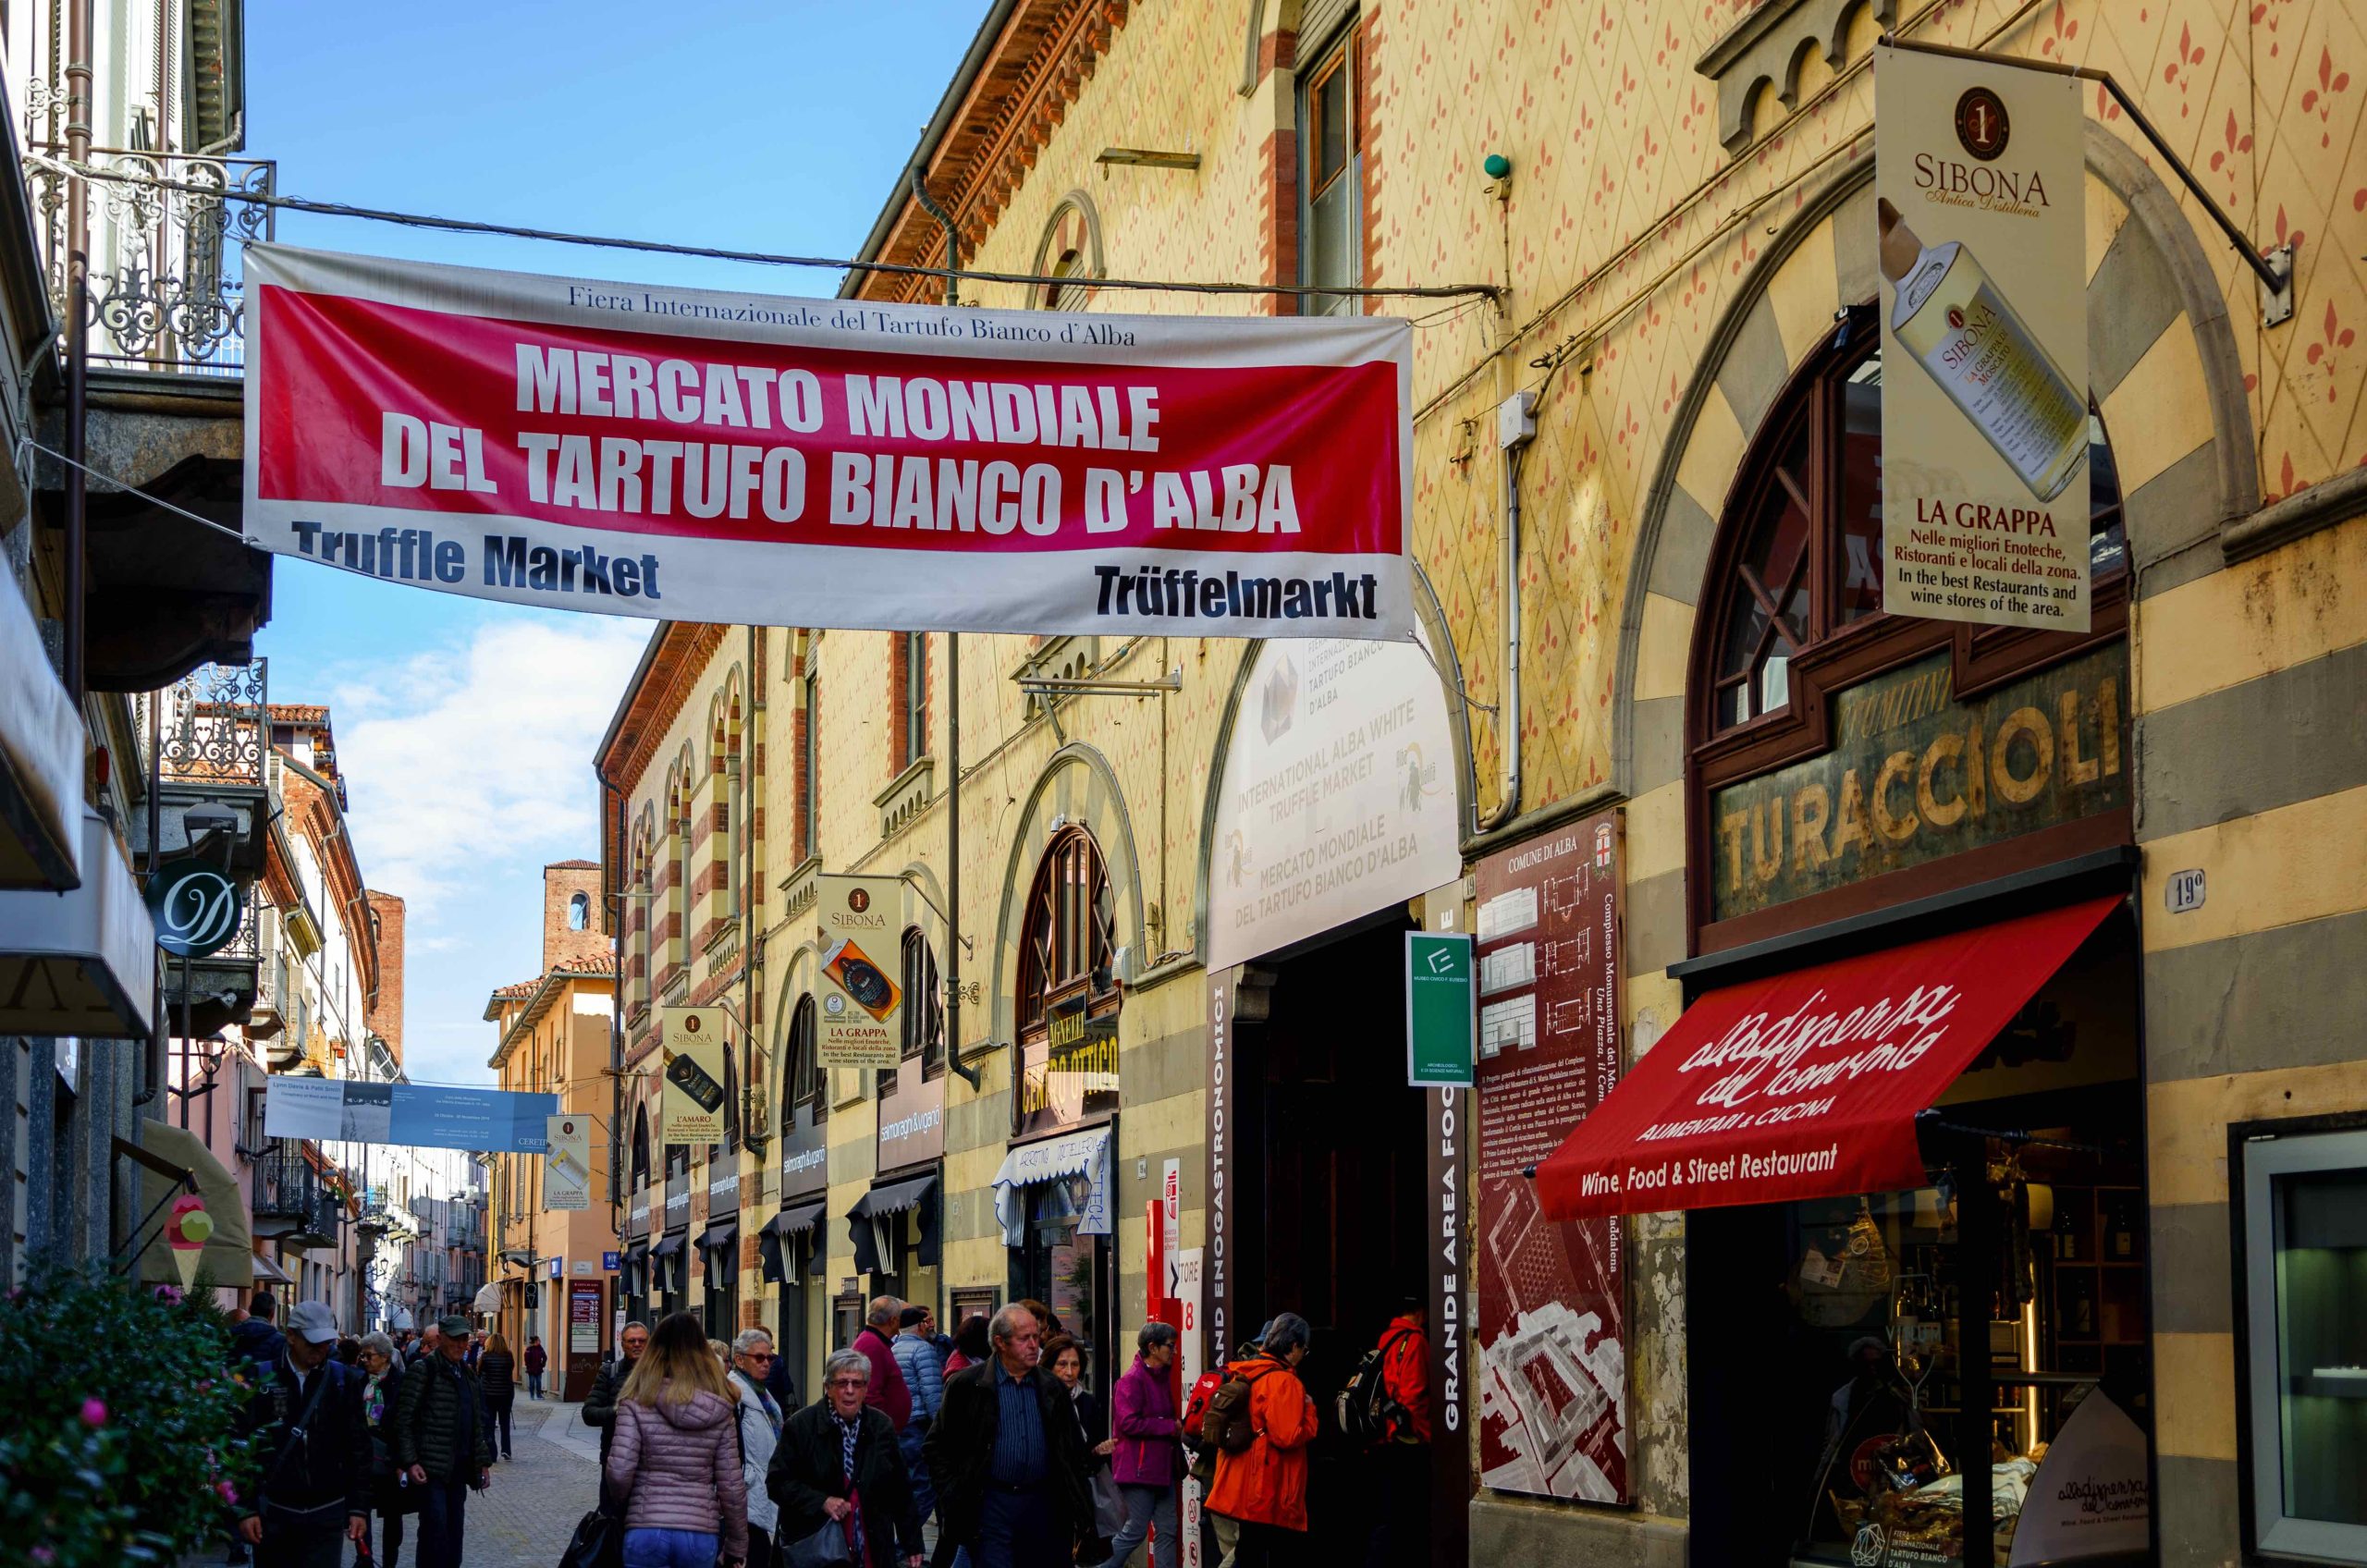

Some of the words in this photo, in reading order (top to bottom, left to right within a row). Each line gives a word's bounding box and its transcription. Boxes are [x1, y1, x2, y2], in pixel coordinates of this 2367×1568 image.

[1915, 153, 2051, 207] SIBONA
[1925, 189, 1975, 208] Antica
[1977, 192, 2040, 219] Distilleria
[568, 286, 633, 312] Fiera
[644, 293, 821, 328] Internazionale
[831, 312, 865, 332] del
[872, 312, 963, 338] Tartufo
[971, 318, 1051, 344] Bianco
[1060, 323, 1136, 347] d'Alba
[1942, 304, 1996, 370] SIBONA
[1977, 345, 2011, 386] MOSCATO
[515, 343, 825, 434] MERCATO
[845, 373, 1159, 453] MONDIALE
[381, 411, 498, 496] DEL
[517, 432, 807, 524] TARTUFO
[829, 453, 1061, 536] BIANCO
[1085, 463, 1302, 534] D'ALBA
[1916, 497, 1948, 527] LA
[1956, 502, 2056, 538] GRAPPA
[291, 520, 466, 583] Truffle
[484, 534, 662, 601] Market
[1894, 545, 1956, 568] Ristoranti
[1959, 557, 1968, 569] e
[1971, 552, 2007, 572] locali
[2010, 557, 2043, 576] della
[2046, 566, 2082, 582] zona.
[1910, 529, 1946, 547] Nelle
[1949, 533, 2000, 555] migliori
[2004, 539, 2067, 562] Enoteche,
[1093, 565, 1378, 621] Trüffelmarkt
[1898, 568, 1912, 583] In
[1917, 568, 1938, 586] the
[1942, 573, 1969, 590] best
[1973, 575, 2049, 599] Restaurants
[2052, 583, 2077, 601] and
[1910, 589, 1943, 605] wine
[1946, 593, 1986, 610] stores
[1989, 594, 2005, 612] of
[2007, 596, 2029, 615] the
[2032, 603, 2065, 618] area.
[1308, 659, 1345, 693] TARTUFO
[1347, 641, 1384, 669] BIANCO
[1309, 687, 1338, 716] D'ALBA
[1238, 746, 1329, 815] INTERNATIONAL
[1332, 730, 1367, 763] ALBA
[1369, 698, 1416, 742] WHITE
[1269, 783, 1319, 826] TRUFFLE
[1322, 752, 1375, 797] MARKET
[1718, 676, 2120, 893] TURACCIOLI
[1259, 849, 1316, 890] MERCATO
[1318, 814, 1386, 864] MONDIALE
[1508, 847, 1542, 874] COMUNE
[1543, 843, 1553, 861] DI
[1554, 835, 1577, 857] ALBA
[1235, 901, 1256, 929] DEL
[1257, 878, 1312, 921] TARTUFO
[1315, 857, 1364, 897] BIANCO
[1367, 833, 1418, 874] D'ALBA
[1465, 877, 1476, 896] 19
[831, 912, 886, 926] SIBONA
[1603, 893, 1613, 959] Complesso
[1596, 987, 1605, 1011] Una
[1605, 962, 1615, 1045] Monumentale
[673, 1033, 713, 1043] SIBONA
[830, 1027, 843, 1036] LA
[846, 1028, 888, 1037] GRAPPA
[1049, 1011, 1085, 1049] AGNELLI
[1596, 1014, 1605, 1058] Piazza,
[1071, 1035, 1118, 1101] OTTICO
[1597, 1061, 1606, 1073] il
[1607, 1046, 1616, 1067] del
[554, 1133, 583, 1142] SIBONA
[1213, 986, 1227, 1299] ENOGASTRONOMICI
[1636, 1112, 1747, 1142] ALIMENTARI
[1737, 1117, 1753, 1129] &
[1754, 1095, 1837, 1126] CUCINA
[1581, 1170, 1624, 1198] Wine,
[1626, 1161, 1666, 1190] Food
[1672, 1161, 1683, 1185] &
[1686, 1154, 1735, 1183] Street
[1739, 1142, 1838, 1179] Restaurant
[1441, 1162, 1457, 1268] AREA
[1609, 1215, 1622, 1274] addalena
[1442, 1273, 1459, 1432] GRANDE
[1890, 1549, 1919, 1560] TARTUFO
[1919, 1552, 1948, 1563] BIANCO
